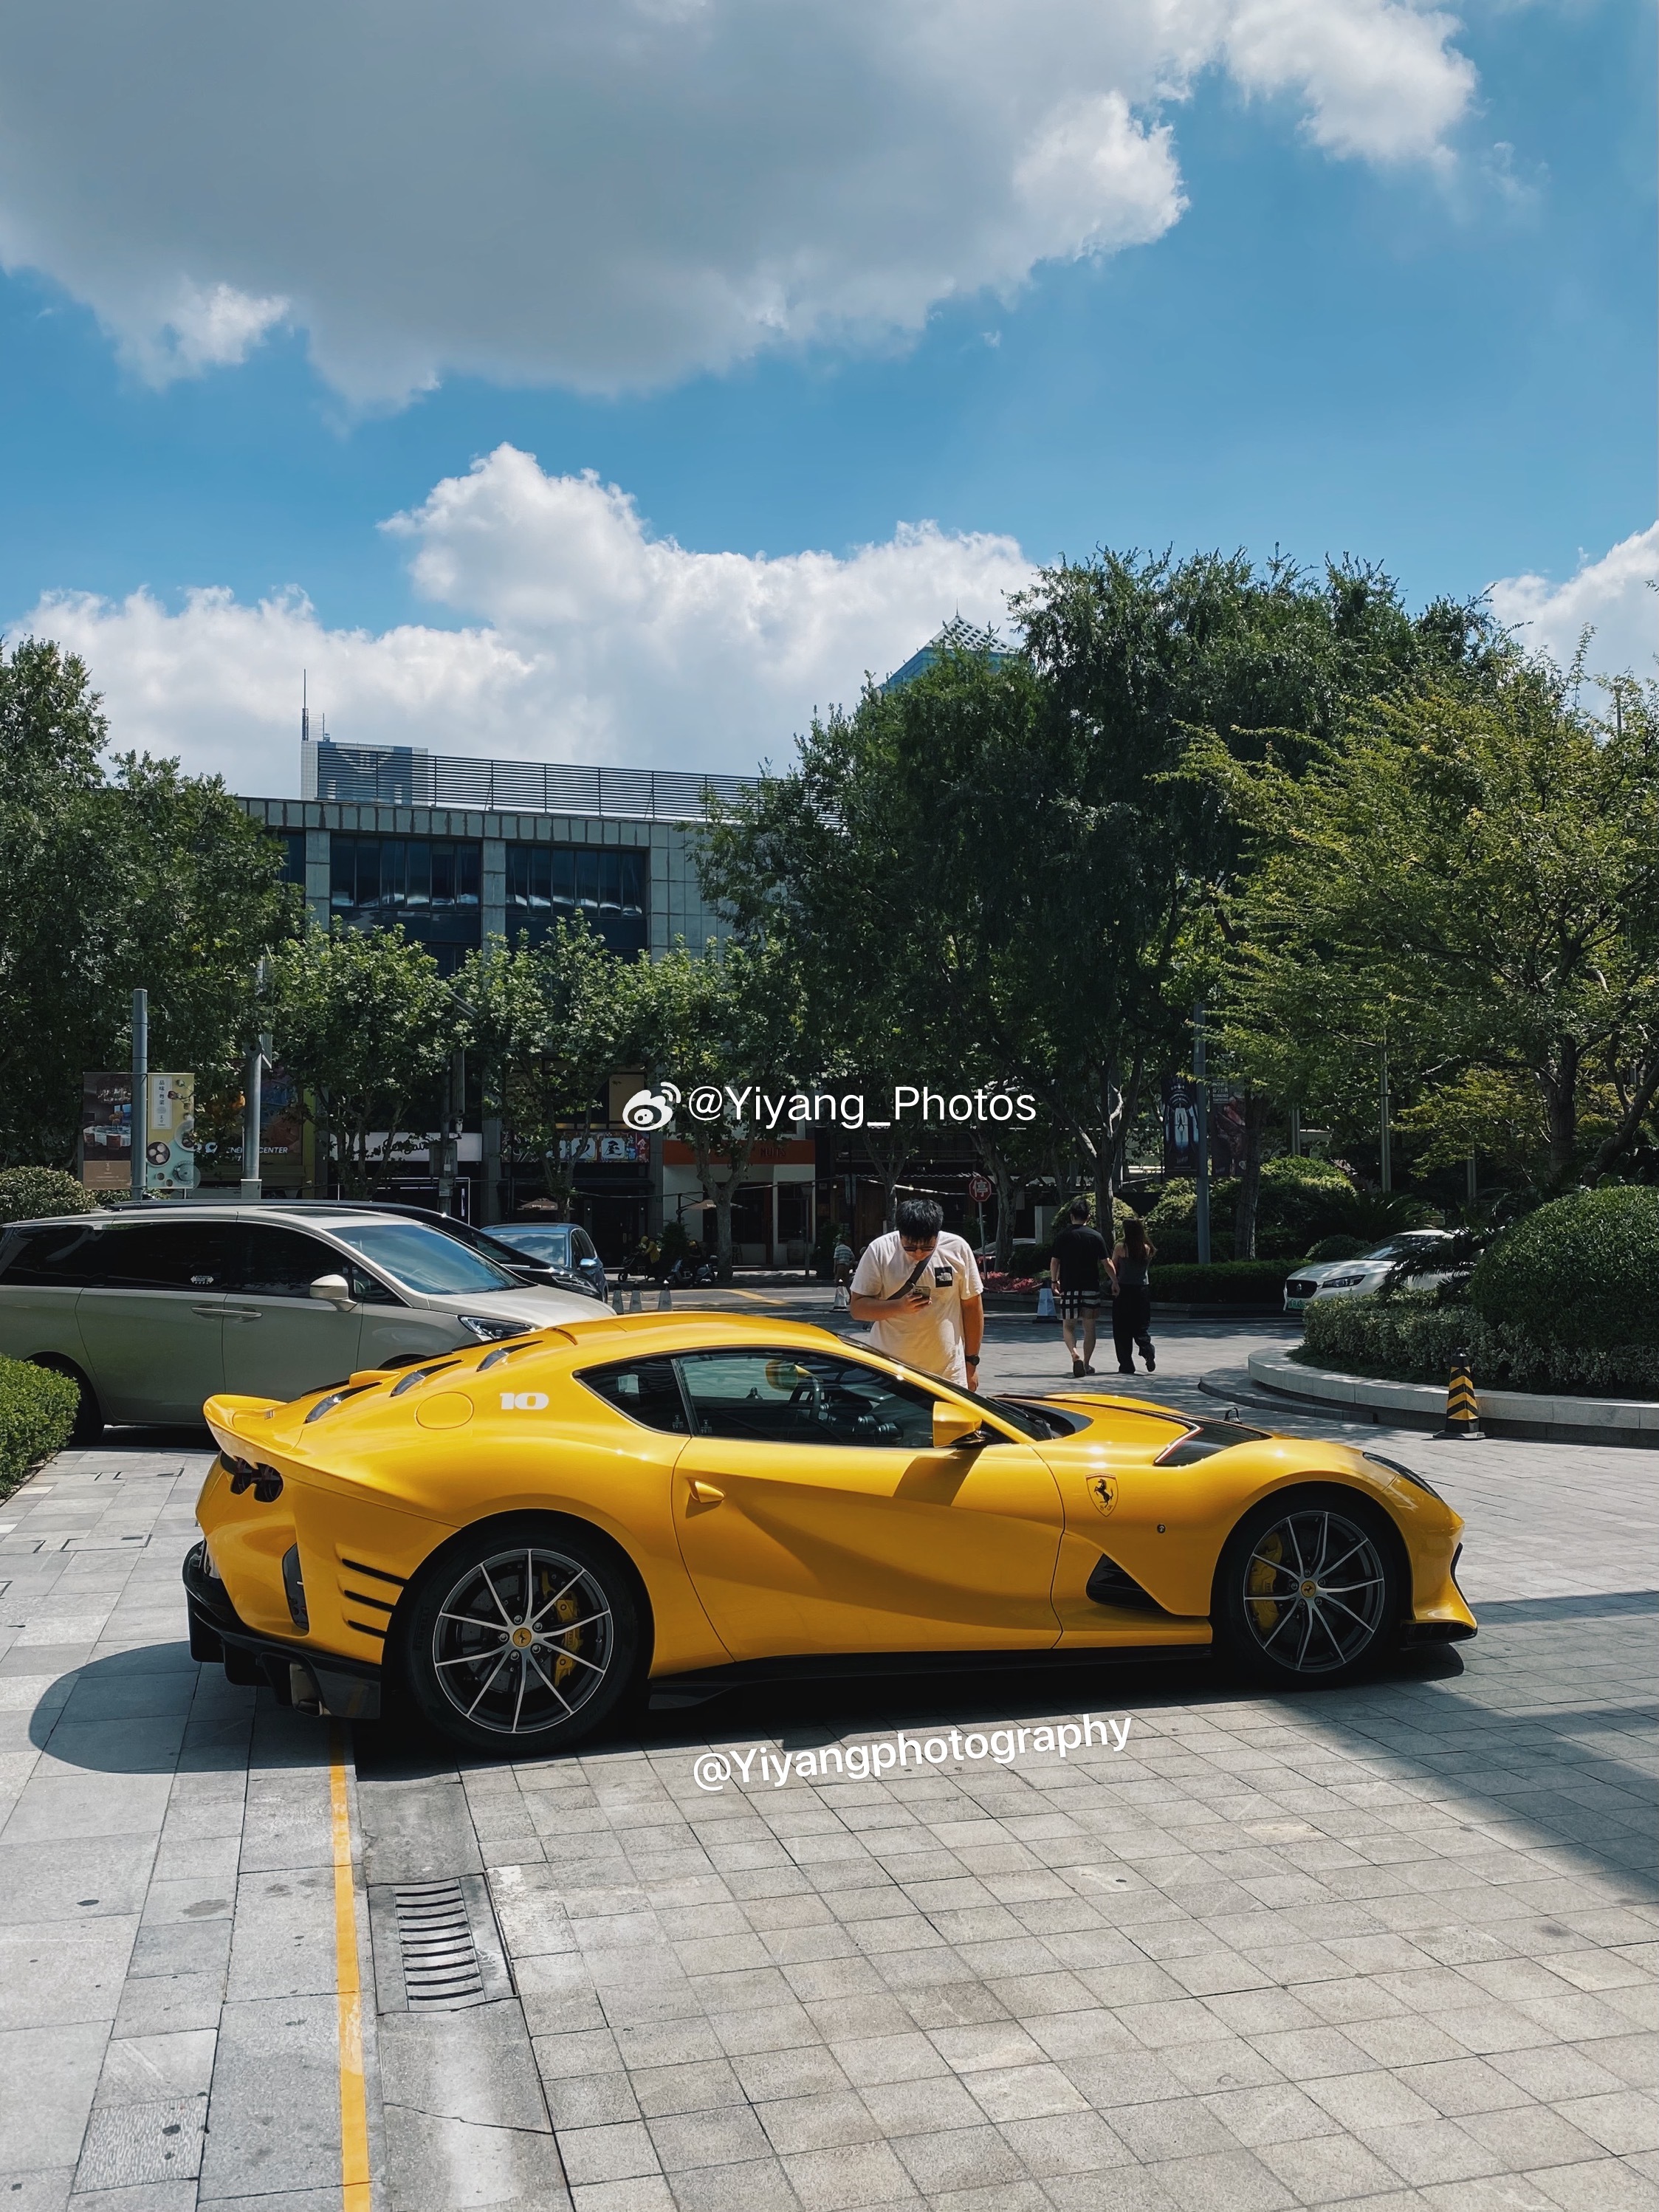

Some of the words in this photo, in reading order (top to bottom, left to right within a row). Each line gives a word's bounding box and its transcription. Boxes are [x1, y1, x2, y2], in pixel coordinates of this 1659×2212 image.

[258, 1146, 288, 1154] CENTER
[972, 1179, 988, 1198] 停
[499, 1392, 549, 1410] 10
